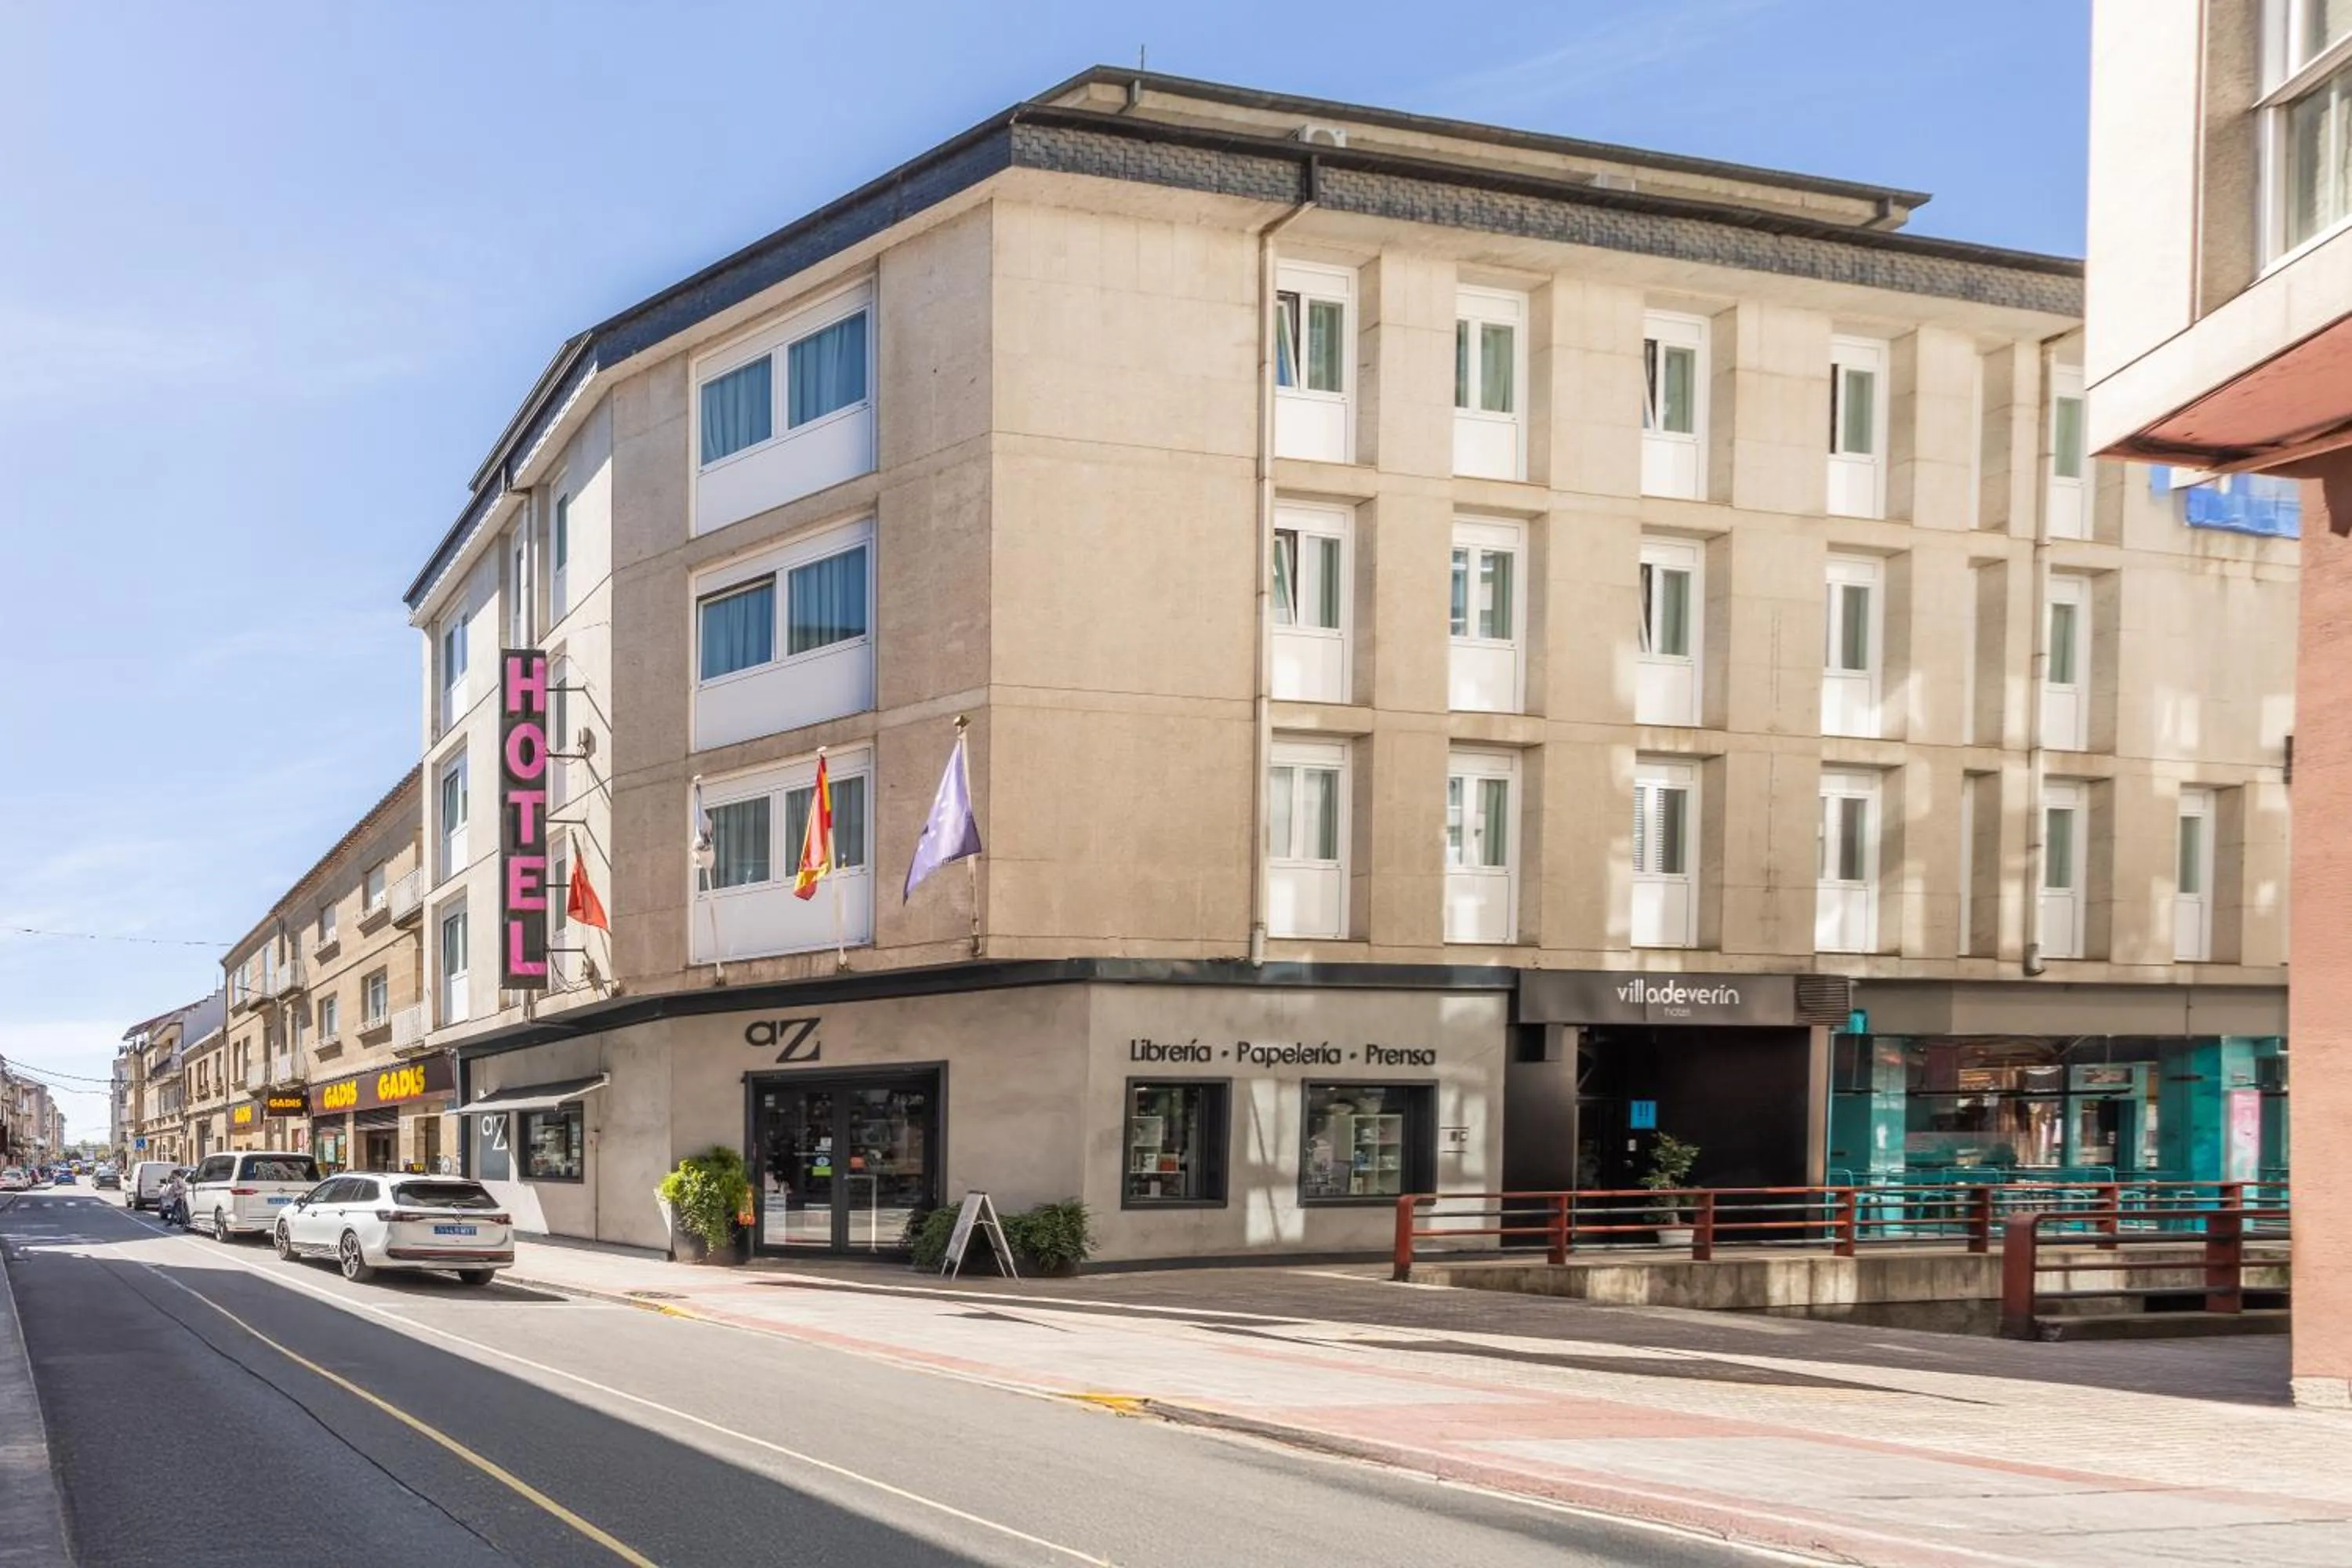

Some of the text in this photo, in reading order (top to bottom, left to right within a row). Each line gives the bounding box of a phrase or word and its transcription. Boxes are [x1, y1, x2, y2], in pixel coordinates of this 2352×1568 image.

[506, 656, 546, 975] HOTEL
[1617, 978, 1740, 1004] villadeverín
[1131, 1038, 1436, 1069] Librería Papelería Prensa
[324, 1079, 358, 1109] GADIS
[377, 1064, 425, 1101] GADIS
[269, 1098, 302, 1108] GADIS
